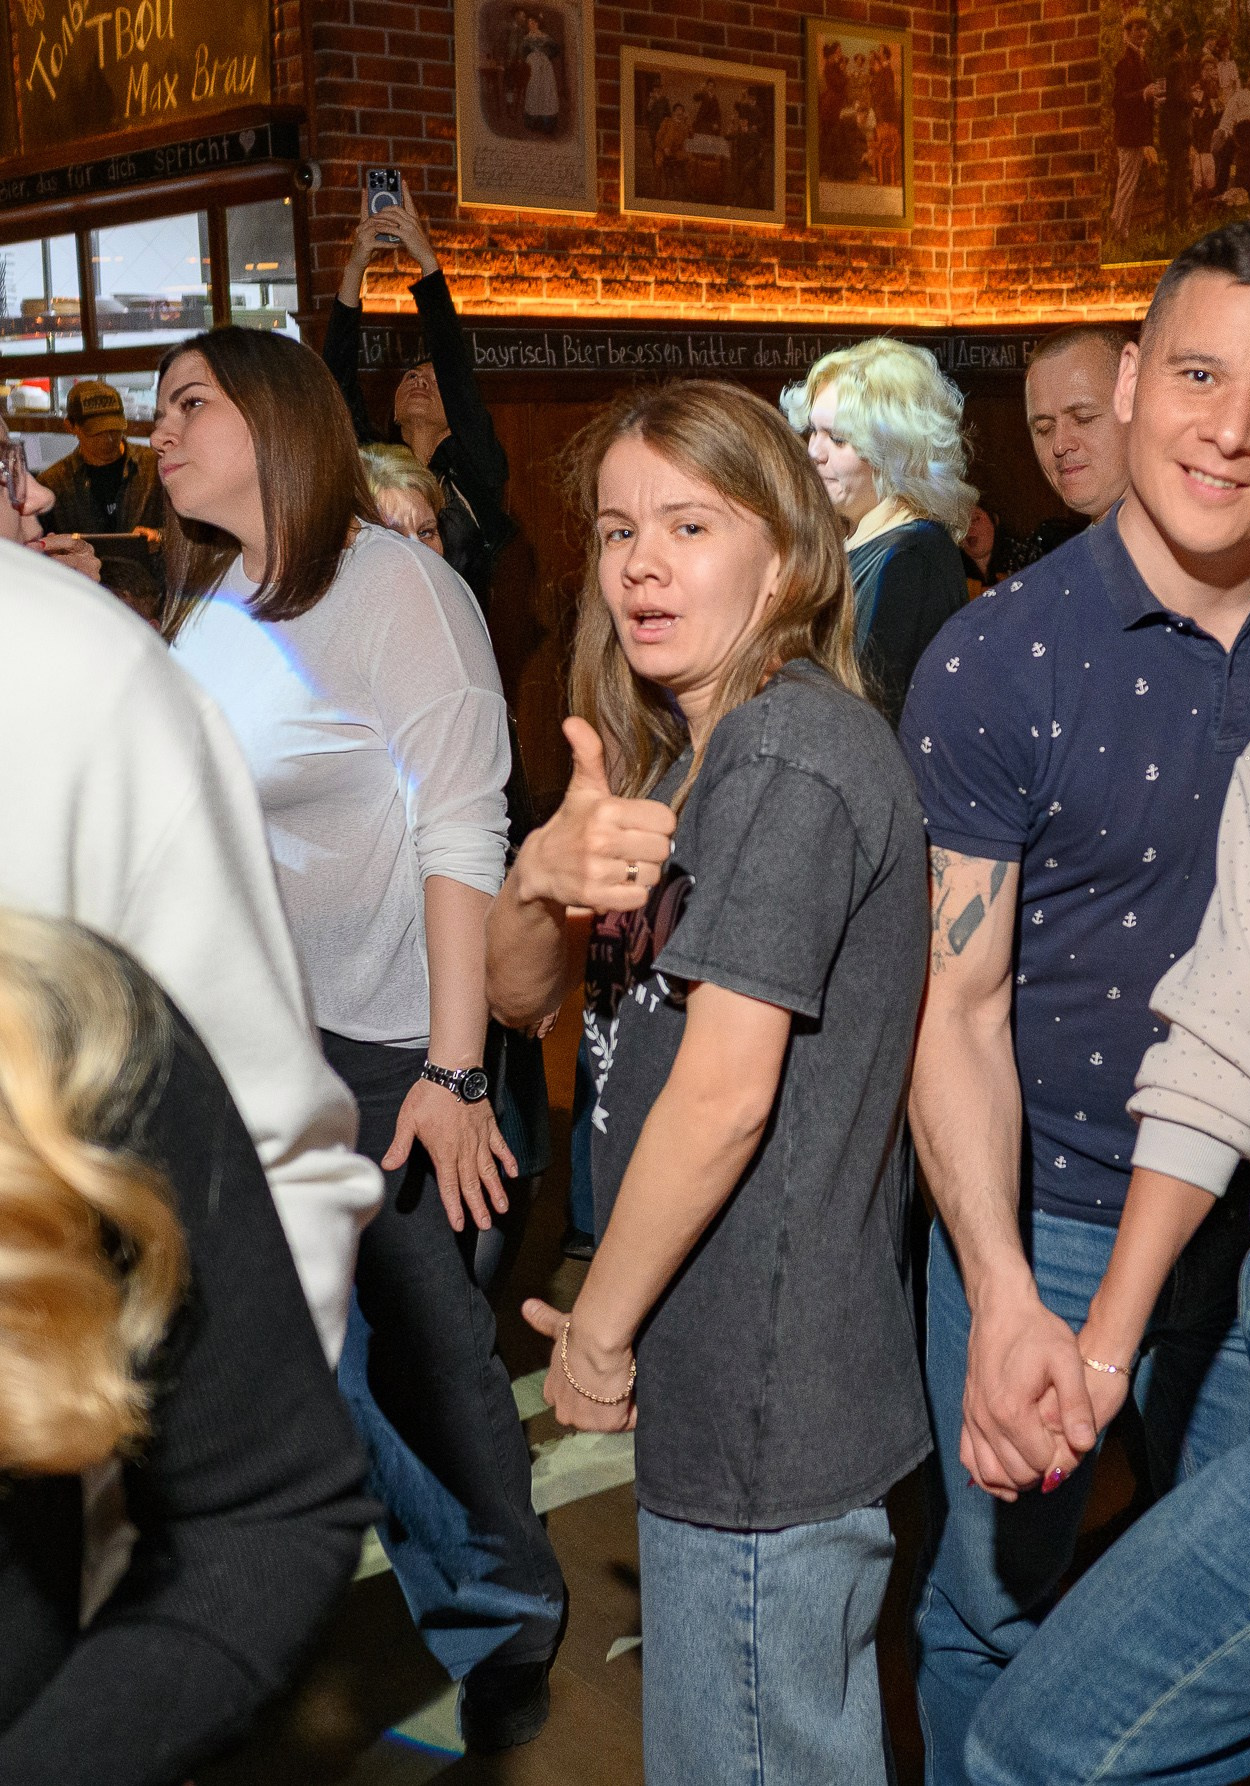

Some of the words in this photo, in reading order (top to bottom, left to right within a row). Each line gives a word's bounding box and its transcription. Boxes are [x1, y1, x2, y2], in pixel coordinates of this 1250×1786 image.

[124, 62, 179, 118] Max
[107, 157, 136, 181] dich
[472, 332, 557, 368] bayrisch
[563, 334, 606, 367] Bier
[608, 337, 683, 367] besessen
[753, 338, 781, 367] den
